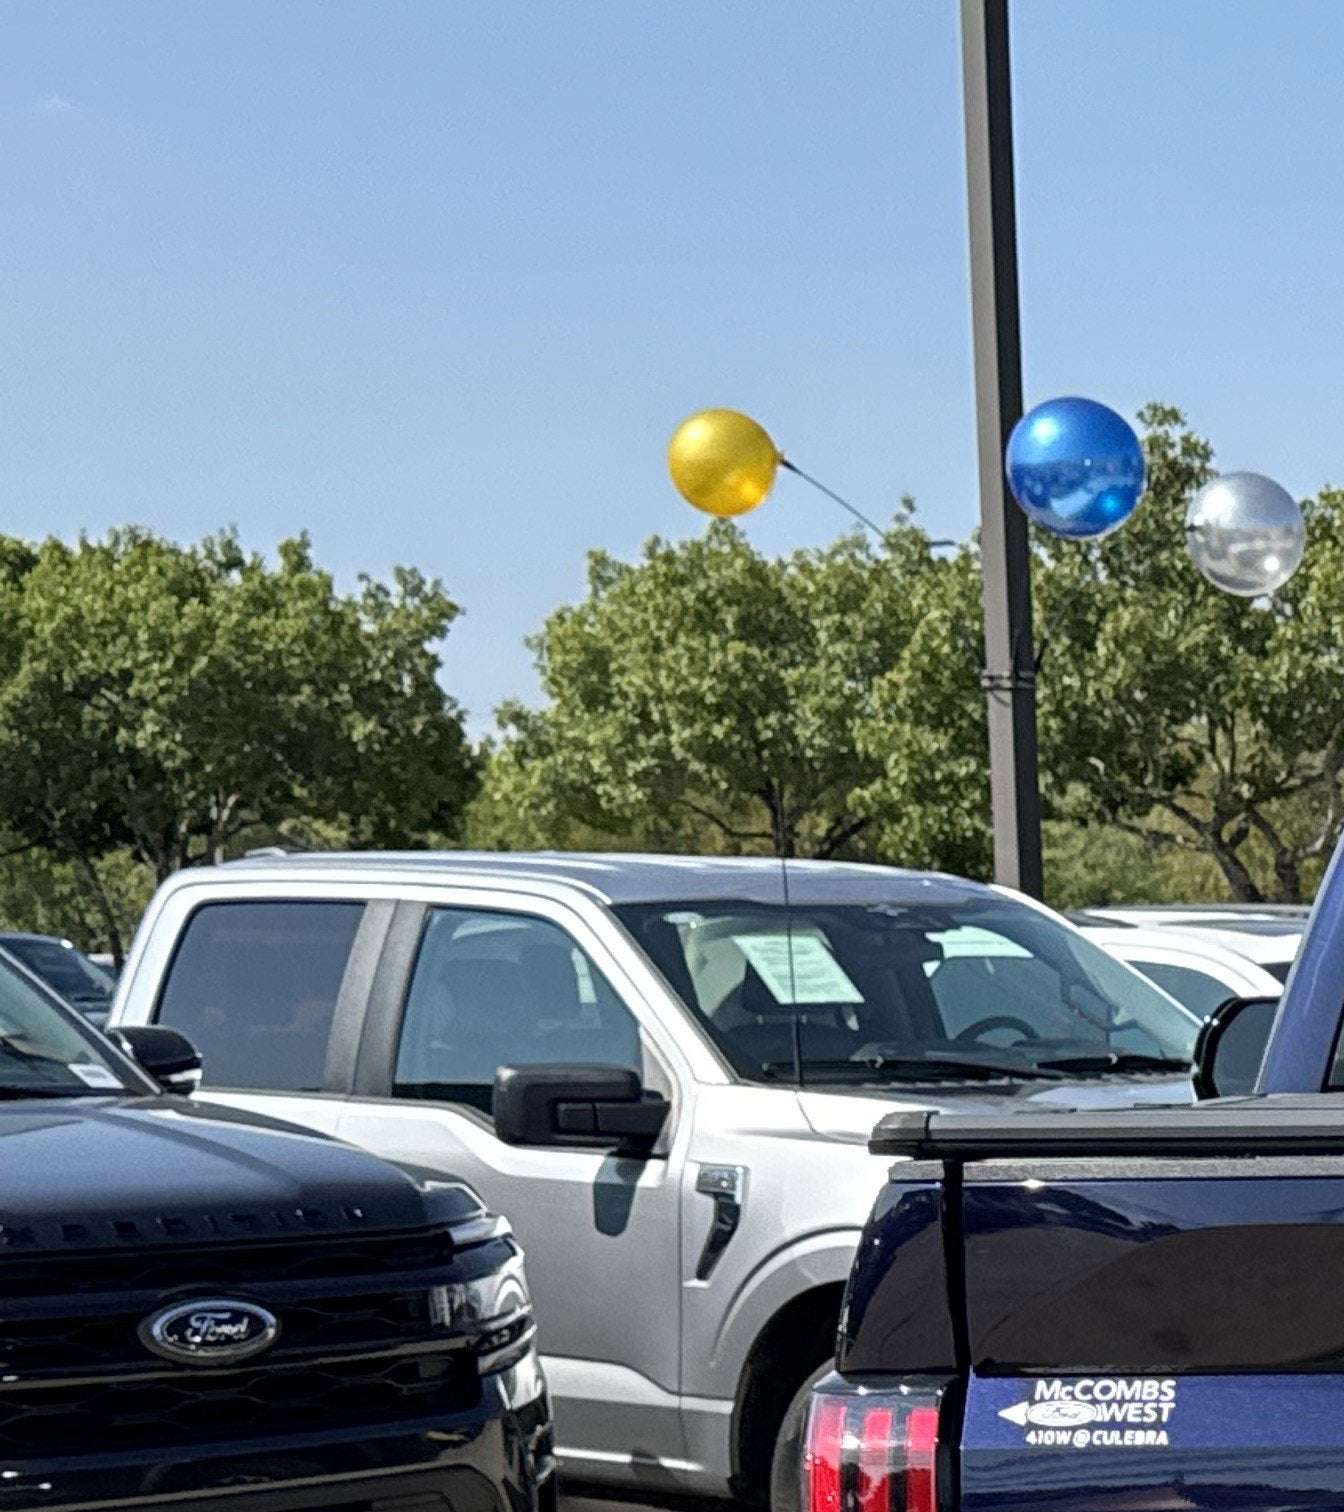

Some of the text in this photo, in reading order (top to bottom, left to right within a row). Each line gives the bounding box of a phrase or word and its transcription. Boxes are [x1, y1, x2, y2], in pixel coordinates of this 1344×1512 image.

[185, 1311, 250, 1341] Ford
[1034, 1379, 1176, 1401] McCOMBS
[1099, 1402, 1176, 1422] WEST
